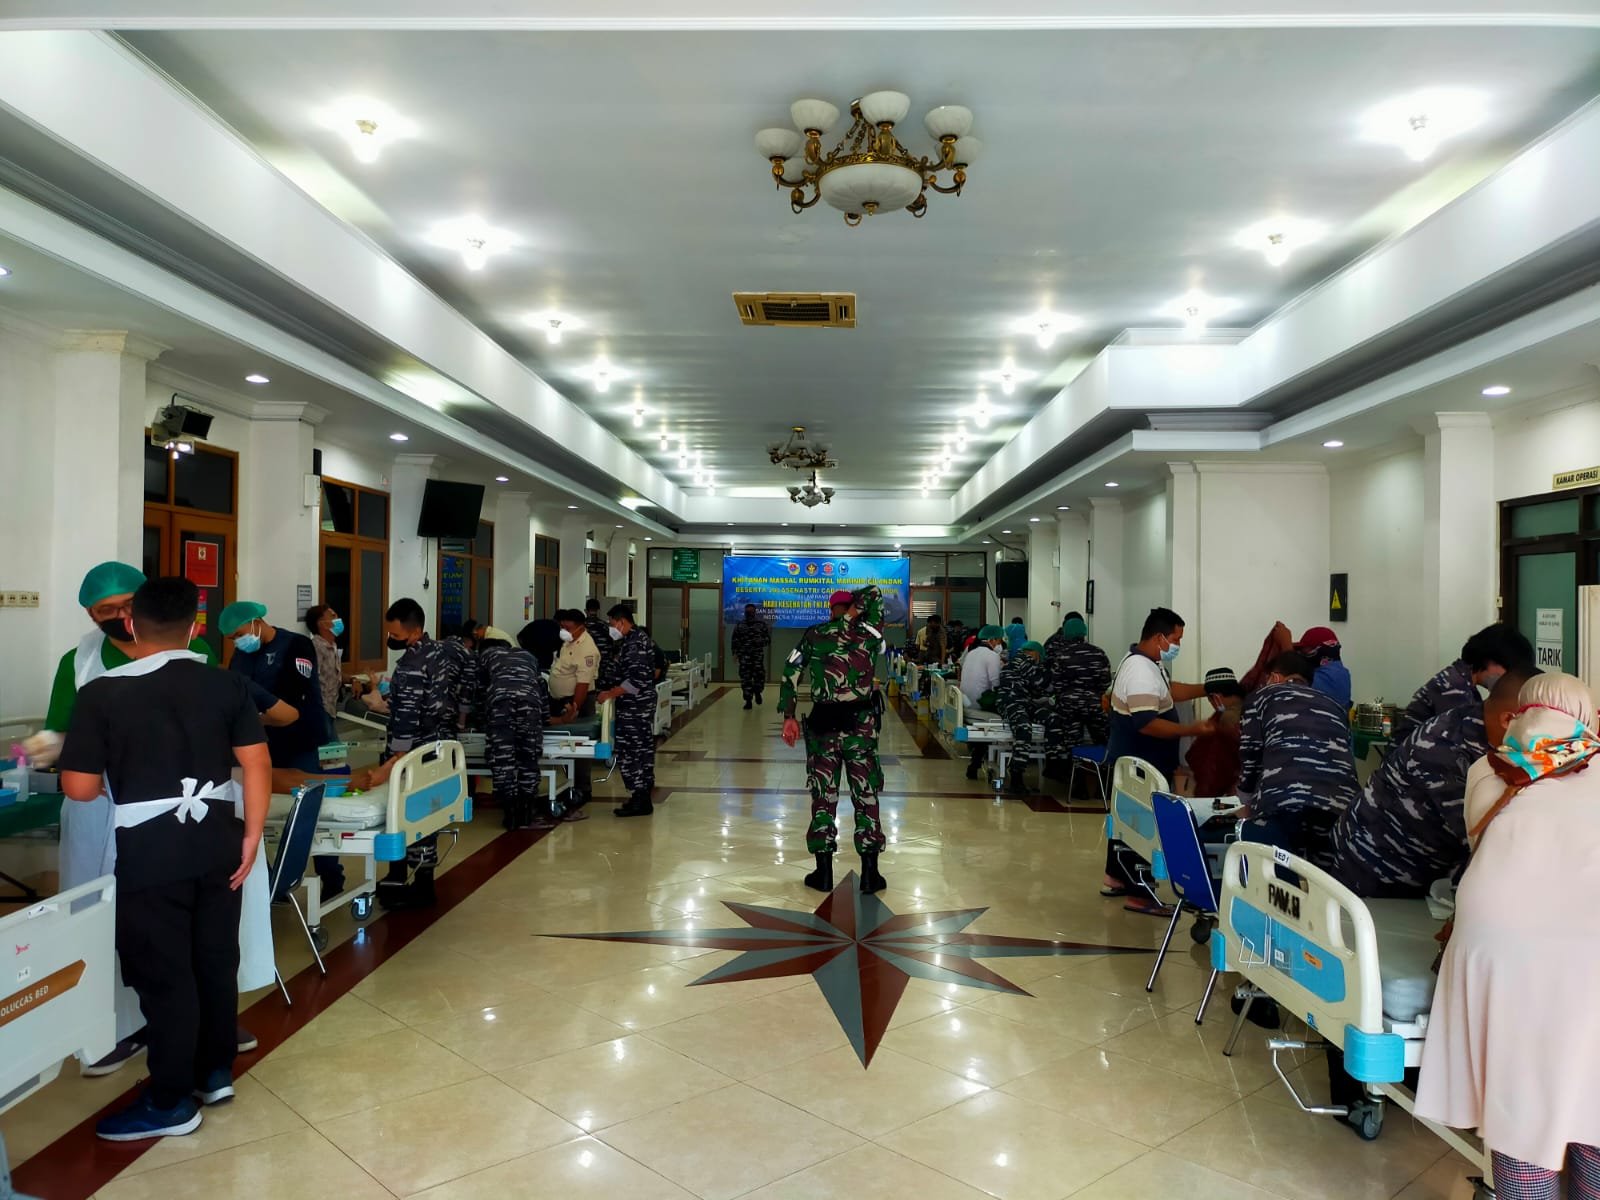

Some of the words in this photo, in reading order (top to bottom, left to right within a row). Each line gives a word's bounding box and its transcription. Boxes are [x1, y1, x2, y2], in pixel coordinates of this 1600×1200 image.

[1556, 474, 1575, 485] KAMAR
[1575, 470, 1598, 481] OPERASI
[1537, 647, 1561, 667] TARIK
[35, 985, 49, 1000] BED
